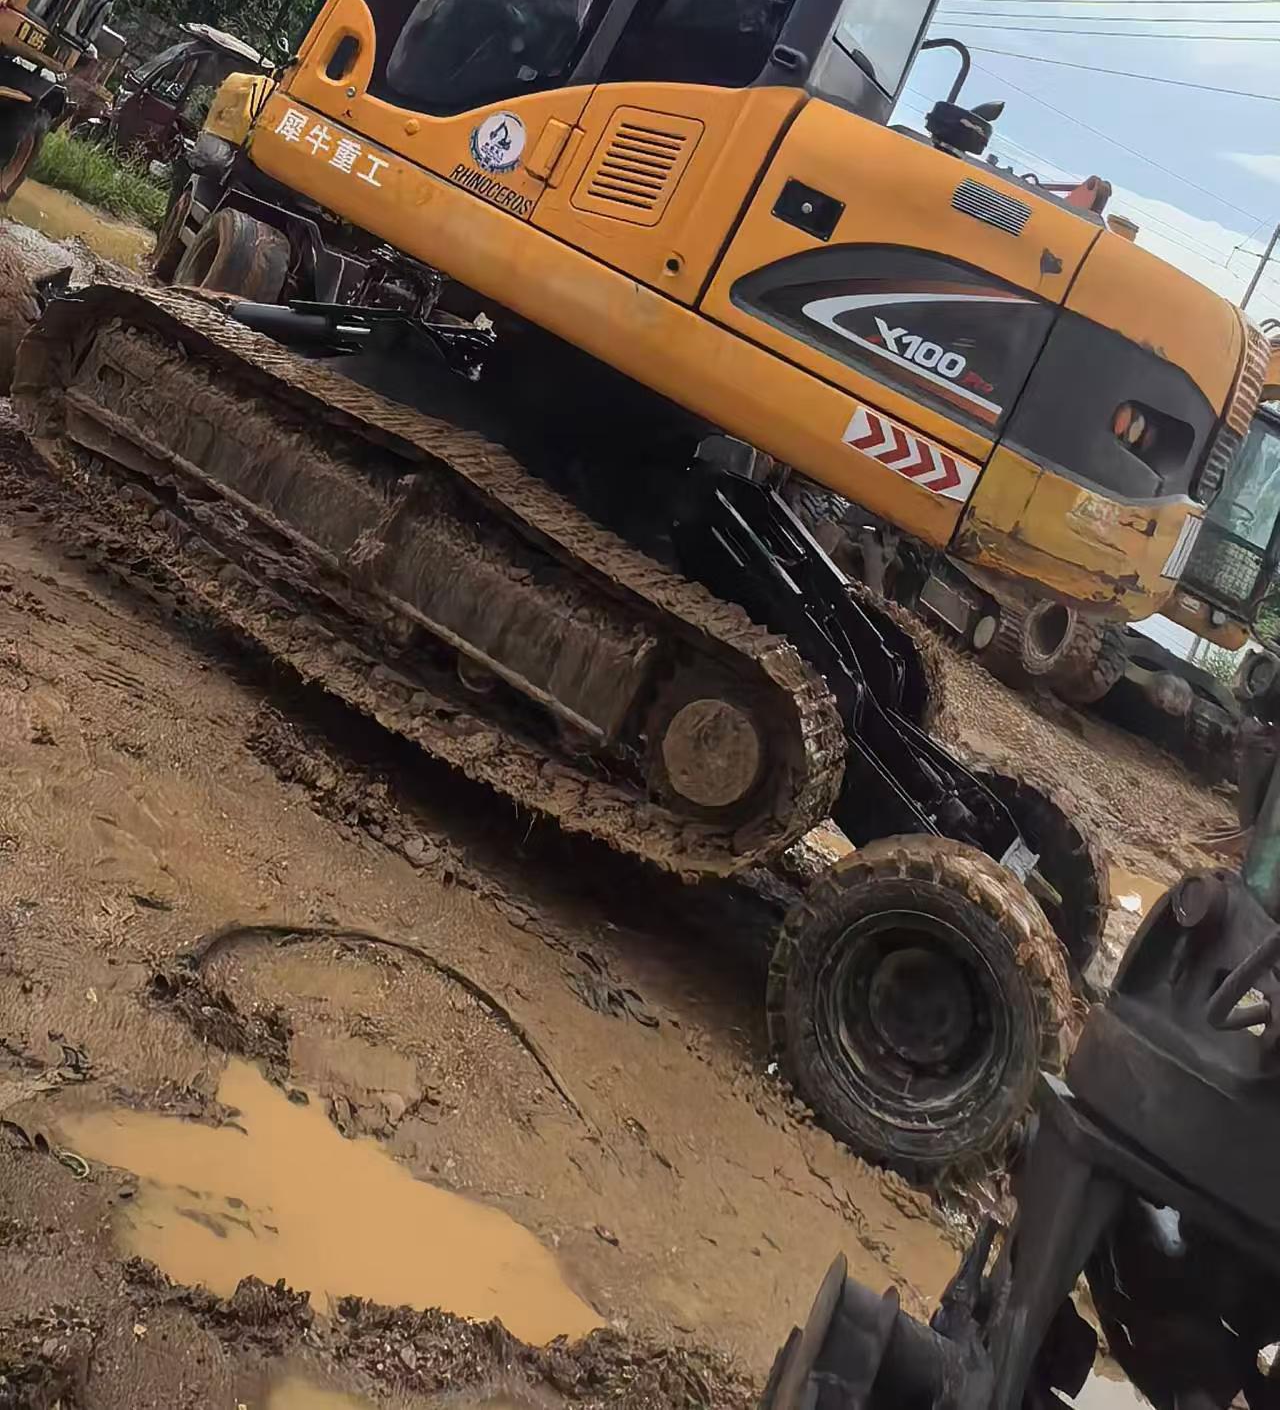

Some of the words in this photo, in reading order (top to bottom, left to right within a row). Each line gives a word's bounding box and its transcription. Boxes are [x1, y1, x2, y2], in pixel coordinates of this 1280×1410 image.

[275, 108, 389, 187] 犀牛重工
[449, 163, 533, 215] RHINOCEROS
[873, 316, 967, 378] X100
